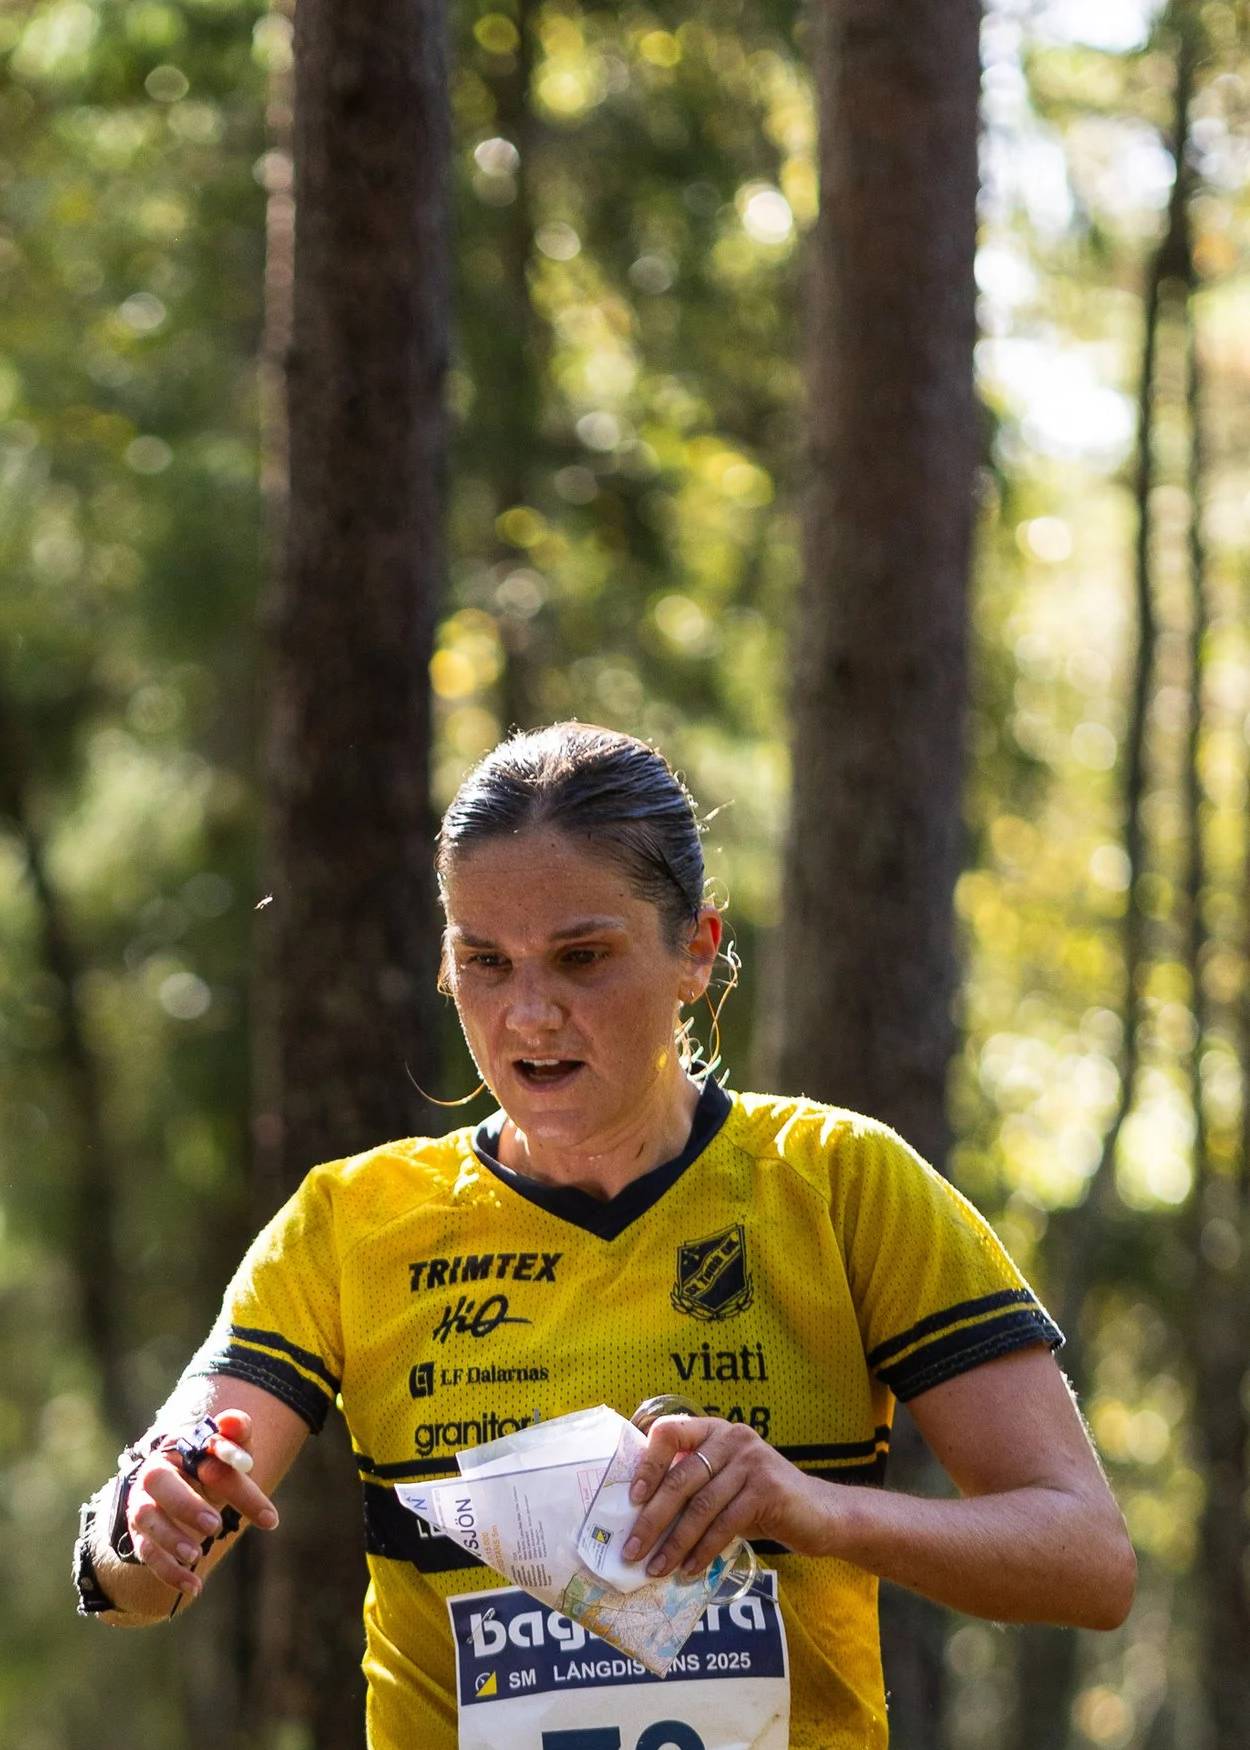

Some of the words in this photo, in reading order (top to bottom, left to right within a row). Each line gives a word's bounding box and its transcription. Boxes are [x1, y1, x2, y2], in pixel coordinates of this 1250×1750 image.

[409, 1253, 564, 1293] TRIMTEX
[441, 1367, 464, 1387] LF
[468, 1364, 550, 1385] Dalarnas
[670, 1341, 769, 1381] viati
[454, 1498, 482, 1557] SJÖN
[470, 1596, 767, 1658] bagra
[509, 1668, 537, 1689] SM
[553, 1655, 701, 1682] LÅNGDISNS
[706, 1652, 751, 1671] 2025
